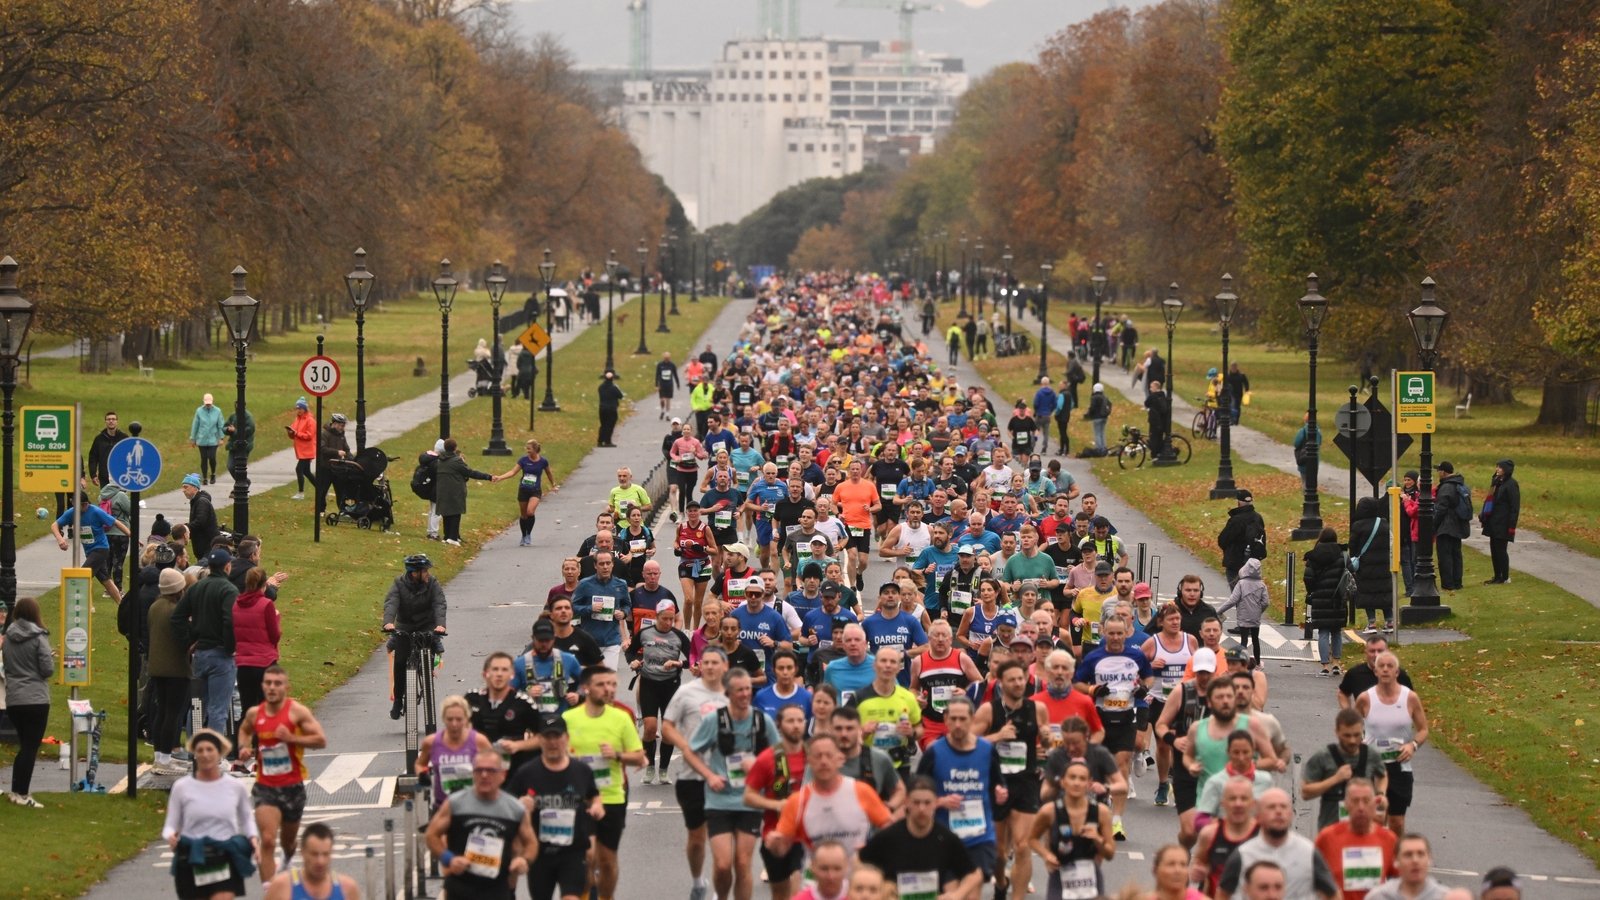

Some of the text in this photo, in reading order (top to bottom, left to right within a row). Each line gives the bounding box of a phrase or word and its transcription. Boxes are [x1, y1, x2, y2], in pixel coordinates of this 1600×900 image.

[310, 366, 330, 382] 30
[27, 442, 66, 450] Stop 8204
[737, 629, 767, 641] ONNY
[874, 635, 908, 645] DARREN
[1100, 673, 1119, 681] LUSK
[950, 768, 979, 781] Foyle
[943, 781, 984, 793] Hospice
